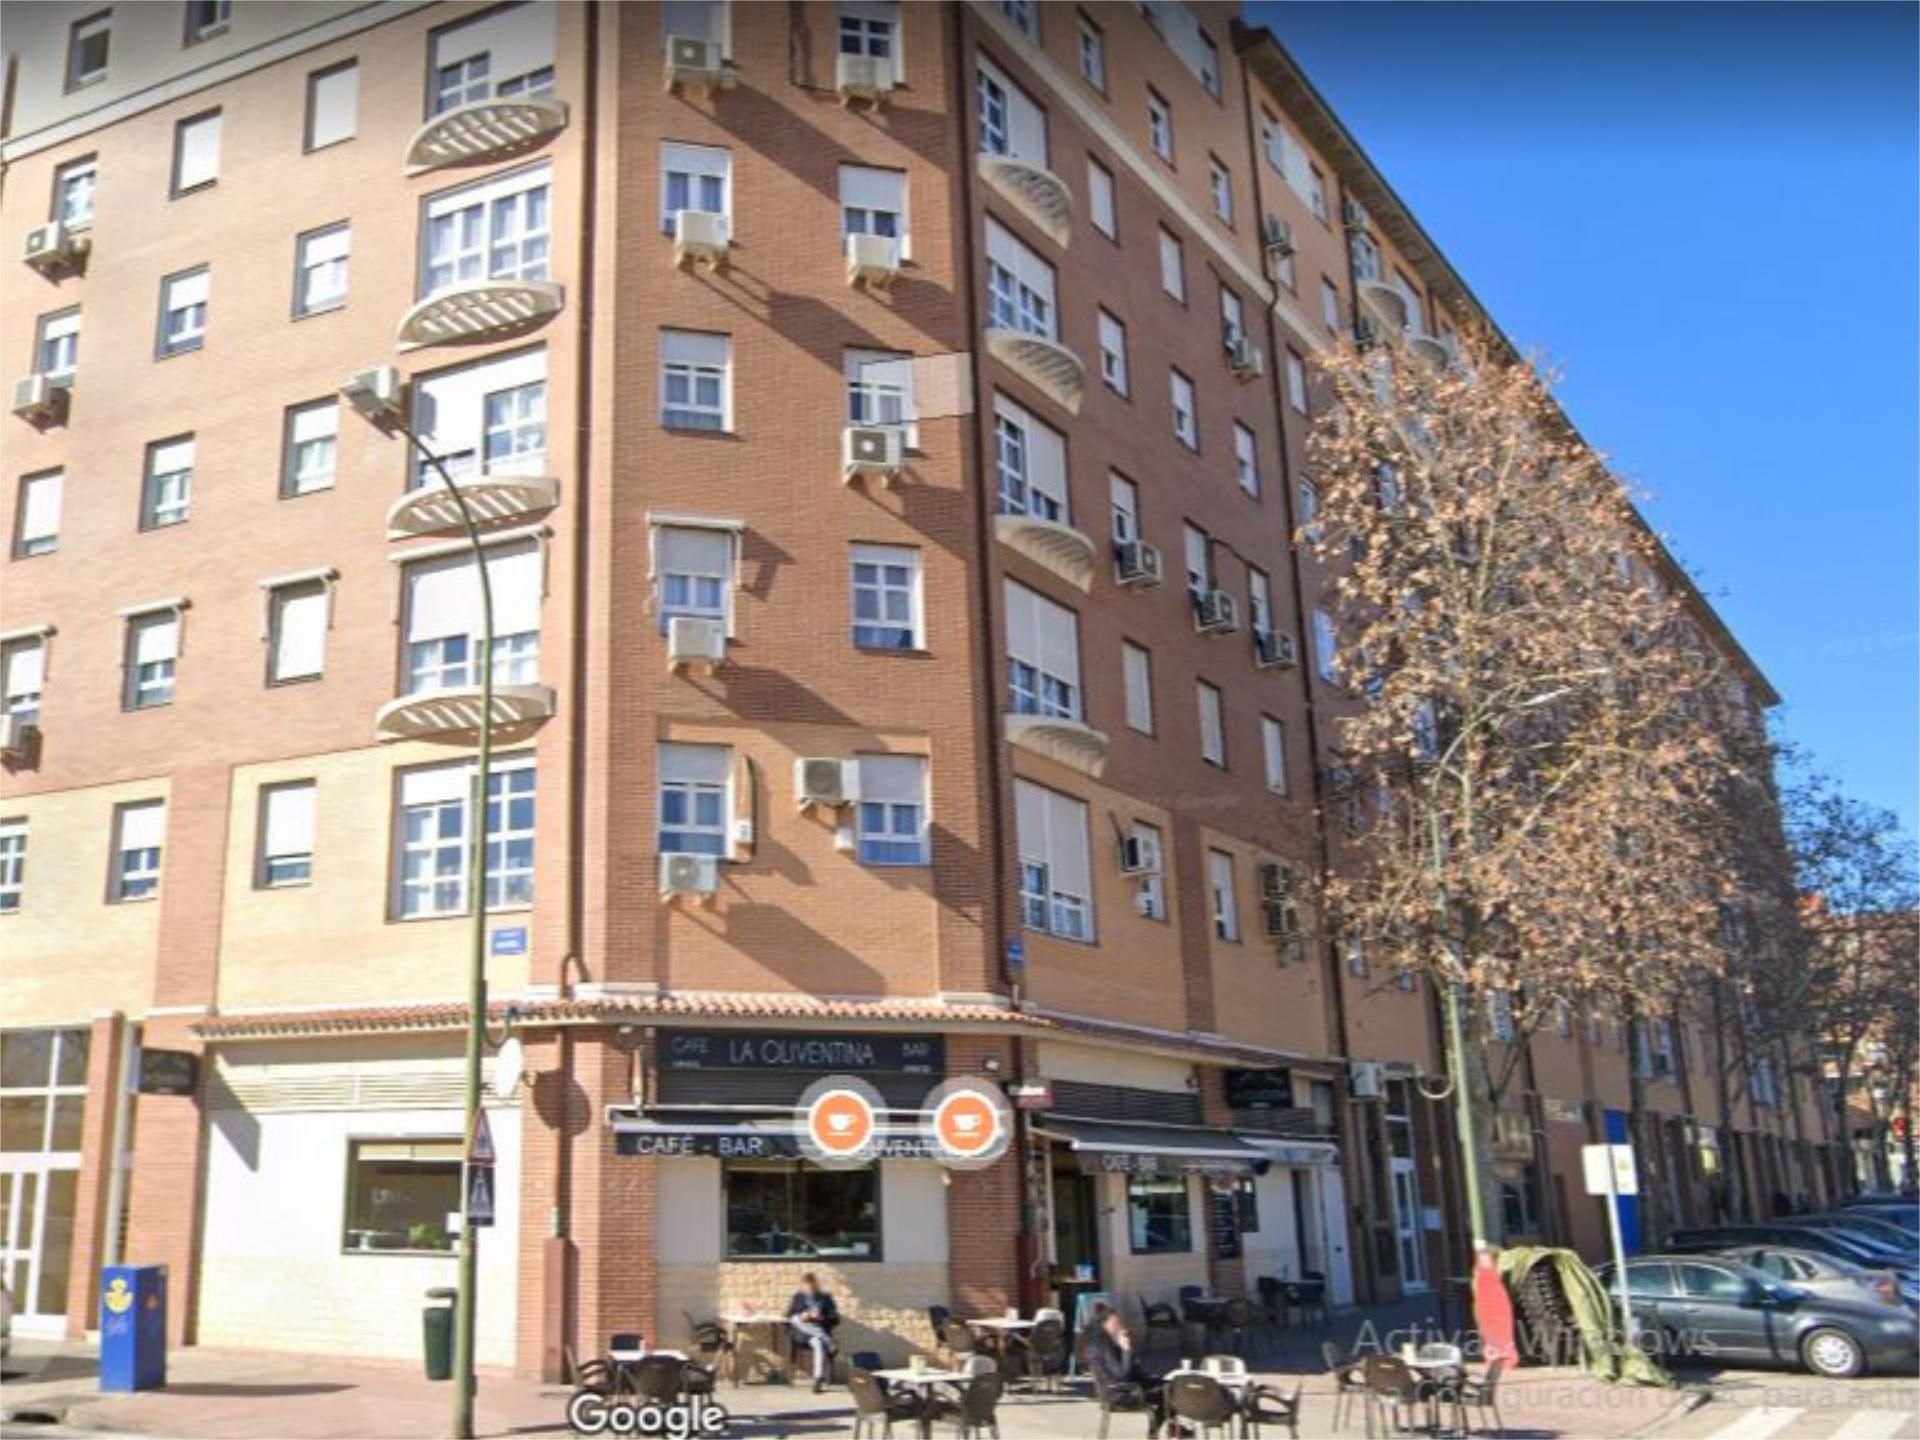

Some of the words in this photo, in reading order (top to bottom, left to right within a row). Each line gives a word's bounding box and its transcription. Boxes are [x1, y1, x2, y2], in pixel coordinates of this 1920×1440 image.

[728, 1039, 755, 1064] LA
[760, 1039, 876, 1064] OLIVENTINA
[719, 1137, 764, 1155] BAR
